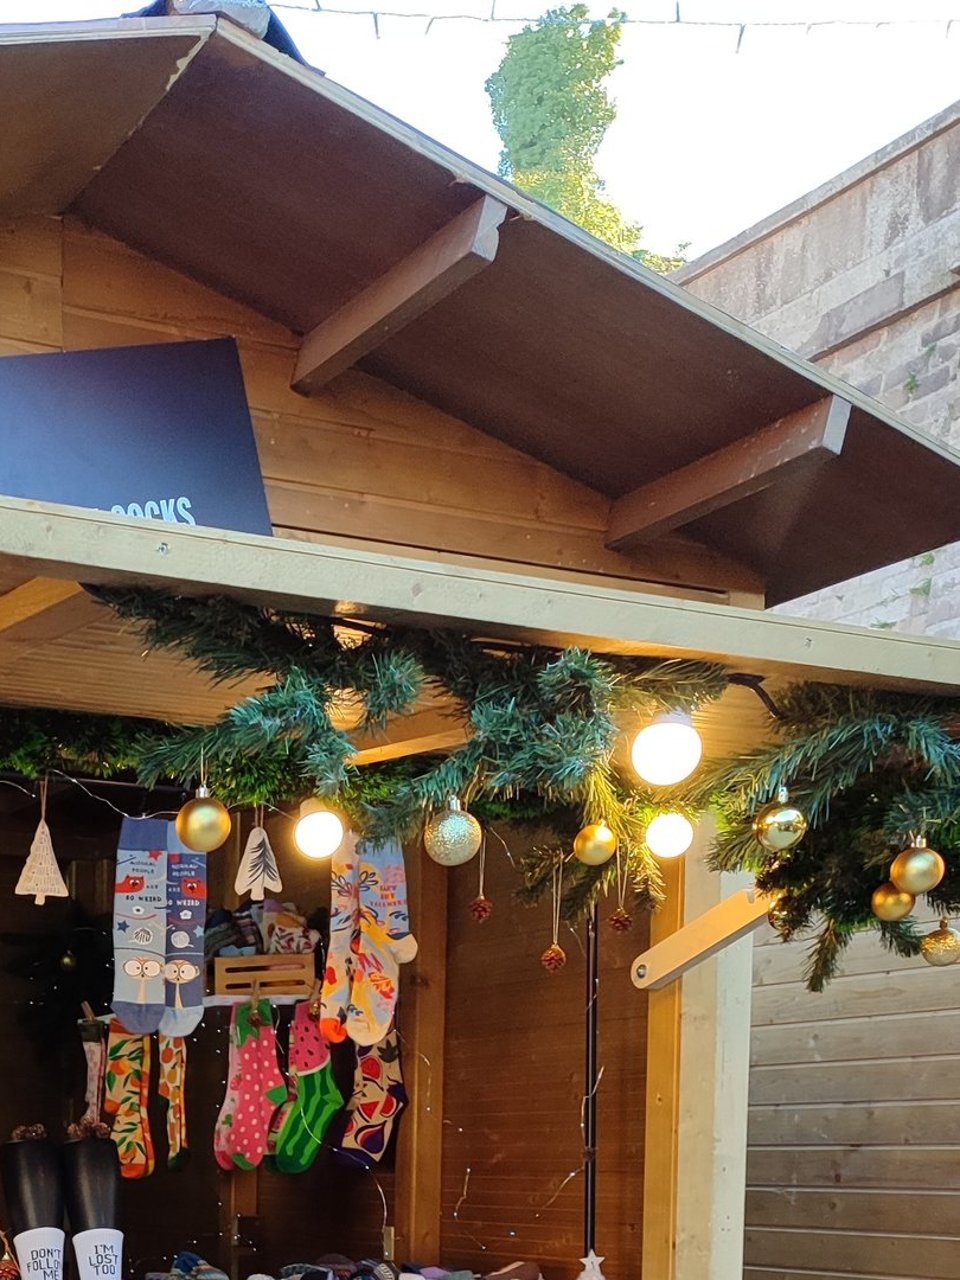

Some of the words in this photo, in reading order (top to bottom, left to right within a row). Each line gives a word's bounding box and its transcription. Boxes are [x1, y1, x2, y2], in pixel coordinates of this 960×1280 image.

[94, 1244, 114, 1254] I'M
[89, 1254, 118, 1266] LOST
[43, 1269, 59, 1280] ME
[94, 1264, 116, 1276] TOO
